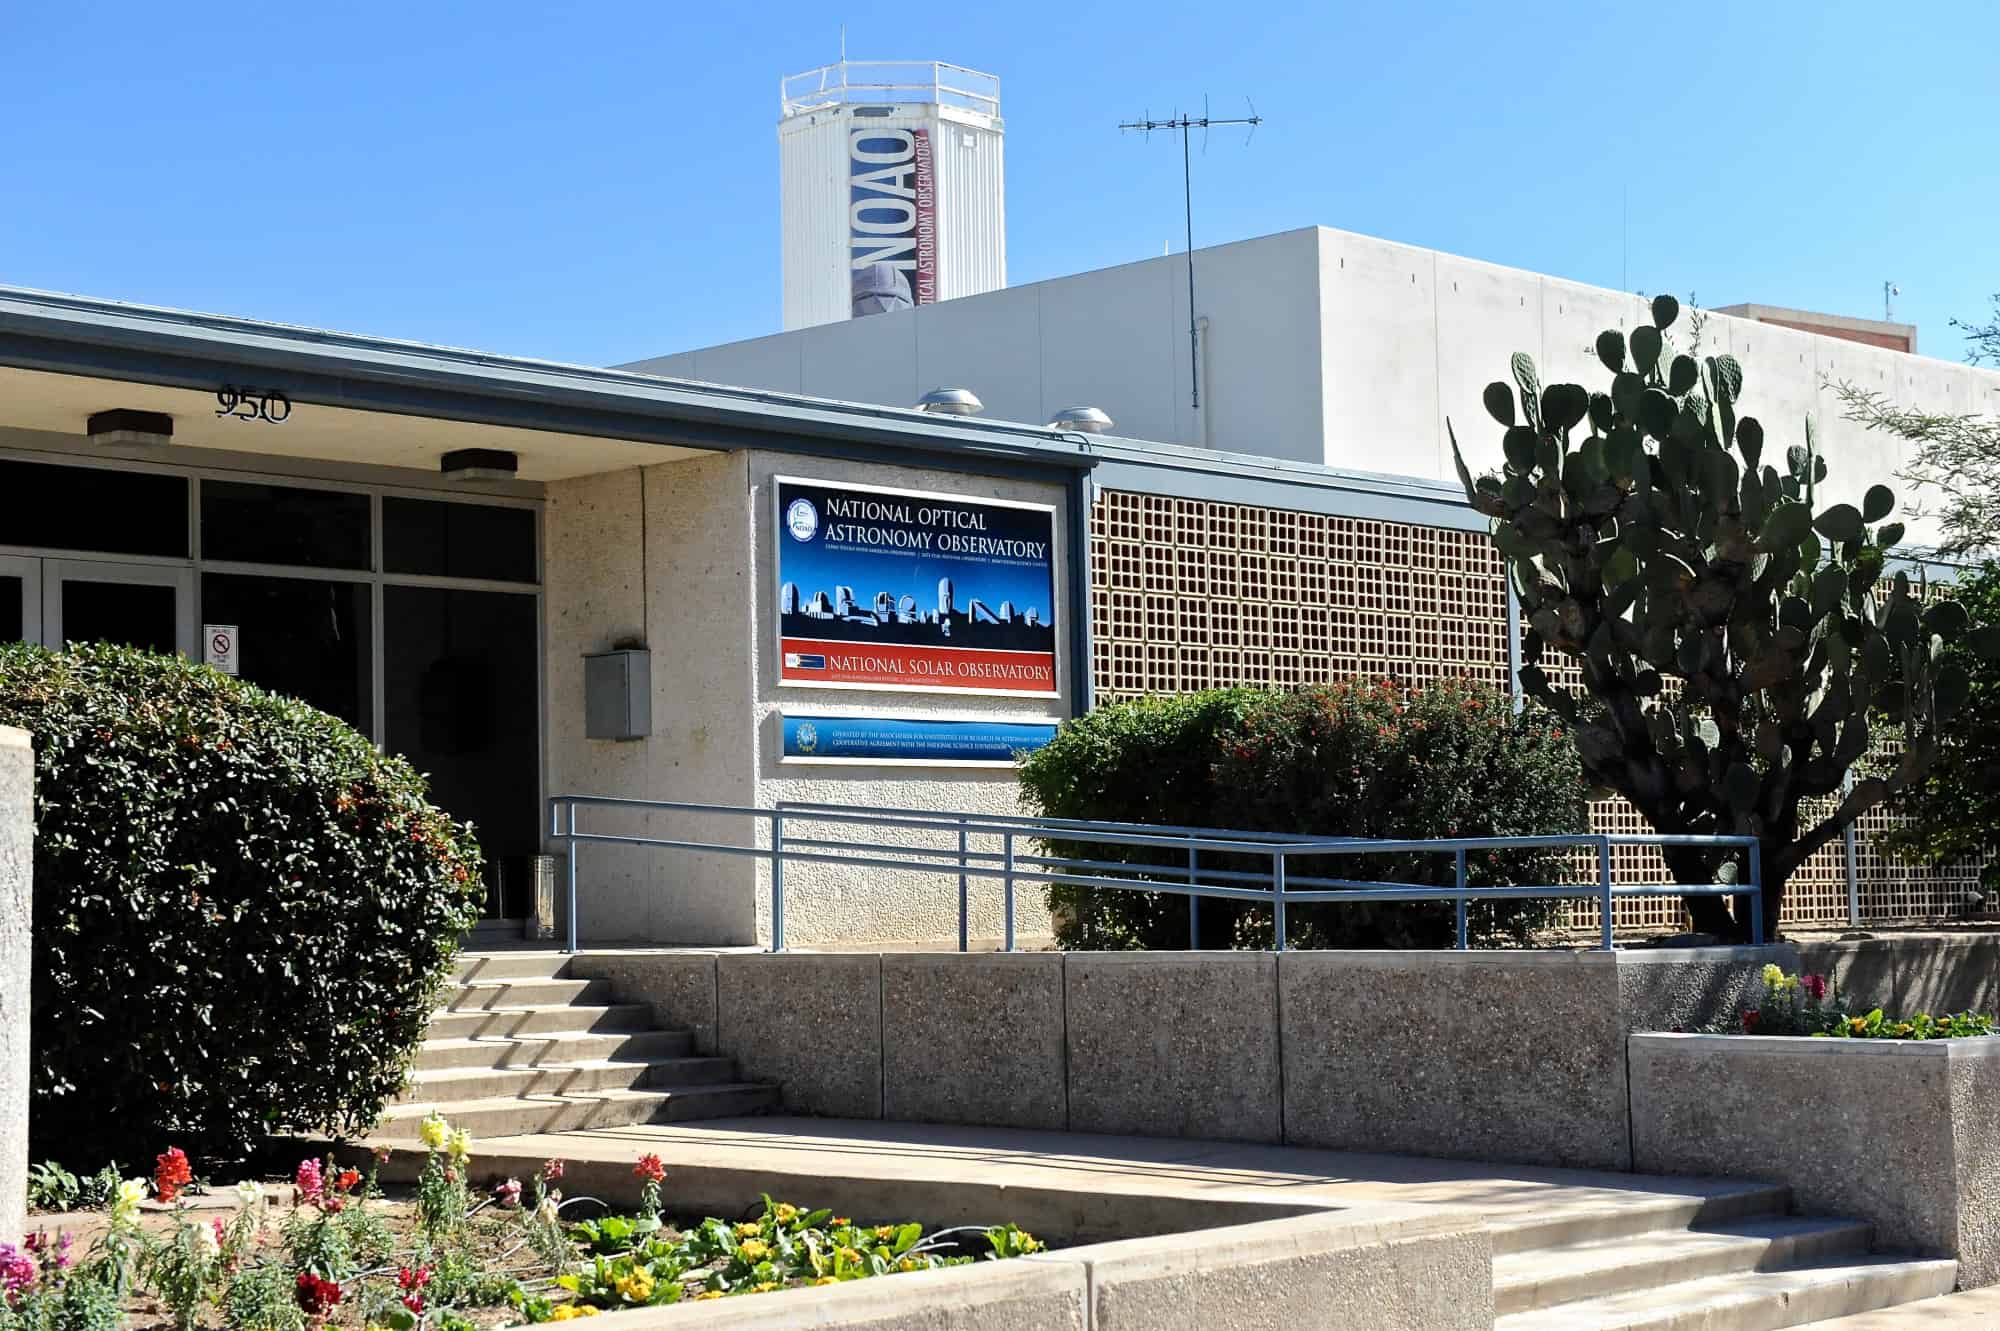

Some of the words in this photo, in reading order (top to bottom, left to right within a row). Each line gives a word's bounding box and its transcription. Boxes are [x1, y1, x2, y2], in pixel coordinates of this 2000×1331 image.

[914, 134, 935, 208] OBSERVATORY
[849, 128, 917, 270] NOAO
[918, 210, 936, 275] ASTRONOMY
[919, 277, 936, 305] TICAL
[215, 388, 291, 424] 950
[826, 498, 913, 523] NATIONAL
[918, 507, 987, 530] OPTICAL
[824, 523, 933, 549] ASTRONOMY
[938, 533, 1046, 559] OBSERVATORY
[830, 655, 905, 674] NATIONAL
[909, 659, 955, 676] SOLAR
[958, 662, 1051, 681] OBSERVATORY
